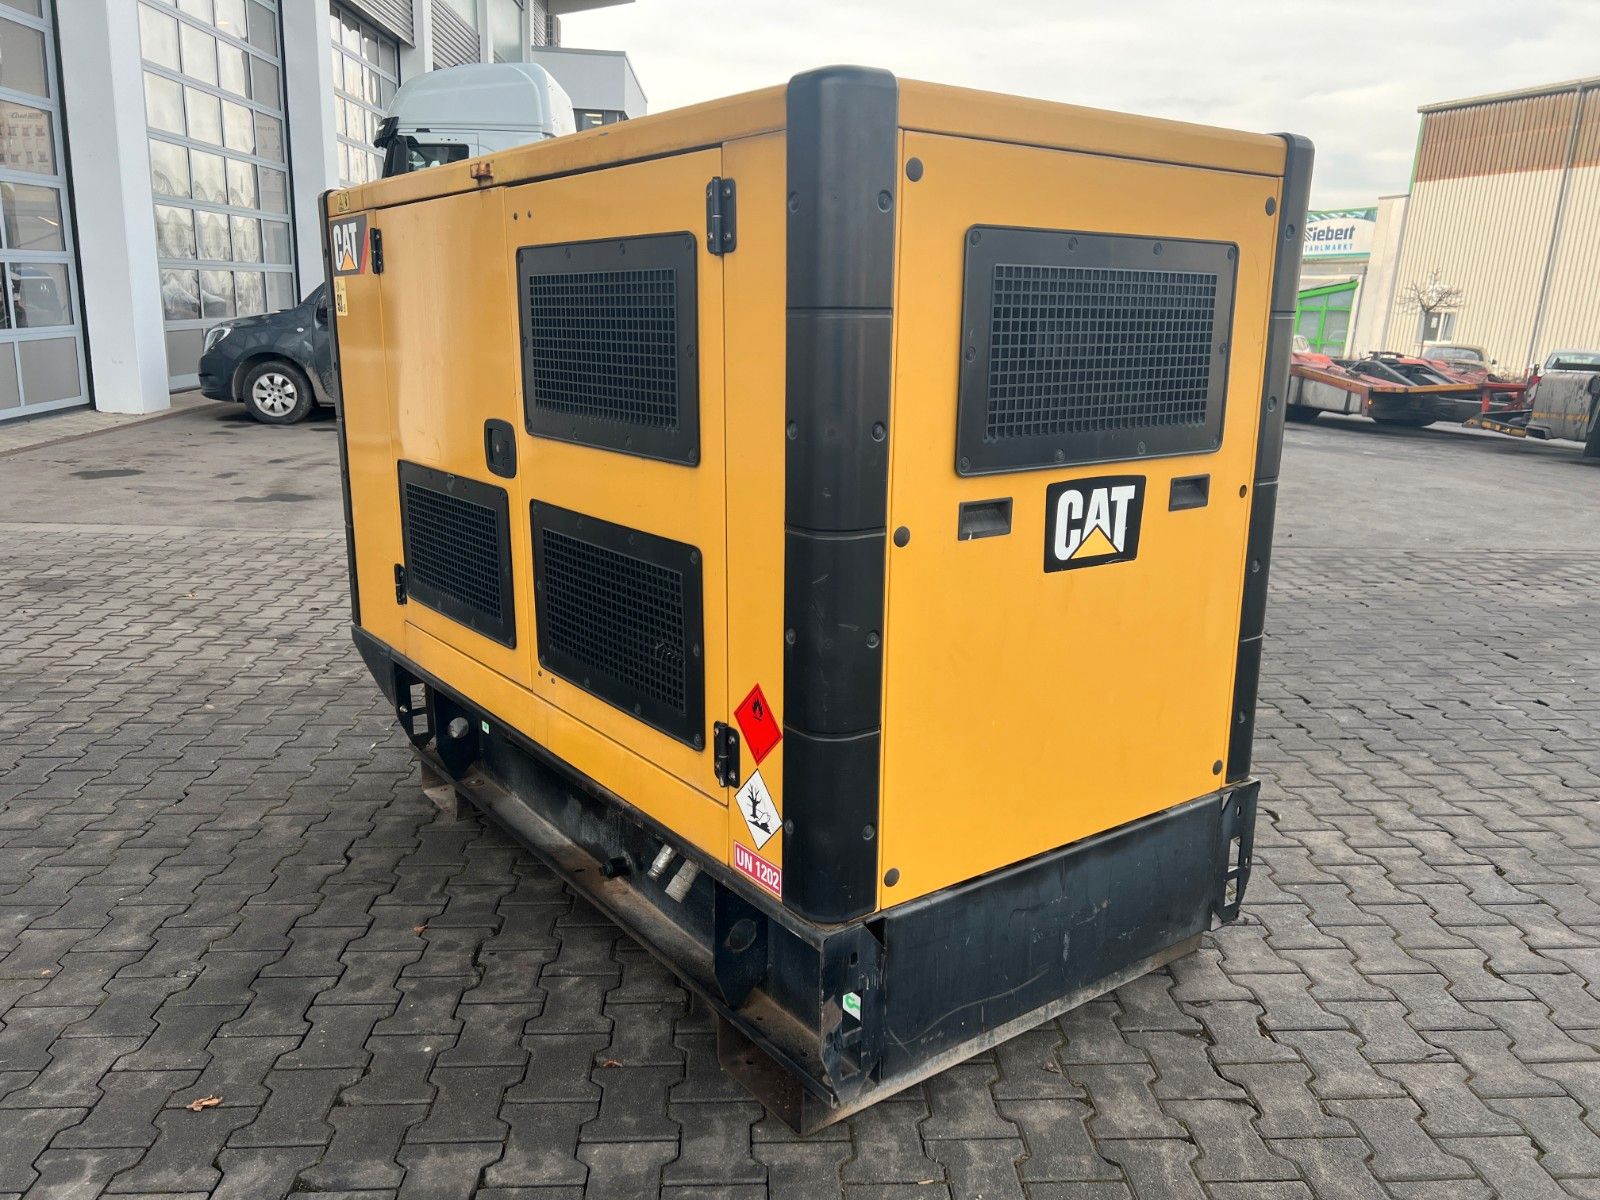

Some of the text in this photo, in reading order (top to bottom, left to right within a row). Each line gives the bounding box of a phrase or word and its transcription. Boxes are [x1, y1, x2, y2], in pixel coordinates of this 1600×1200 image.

[333, 222, 359, 271] CAT
[1304, 243, 1353, 252] TAHLMARKT
[1054, 484, 1136, 561] CAT
[736, 846, 780, 890] UN 1202
